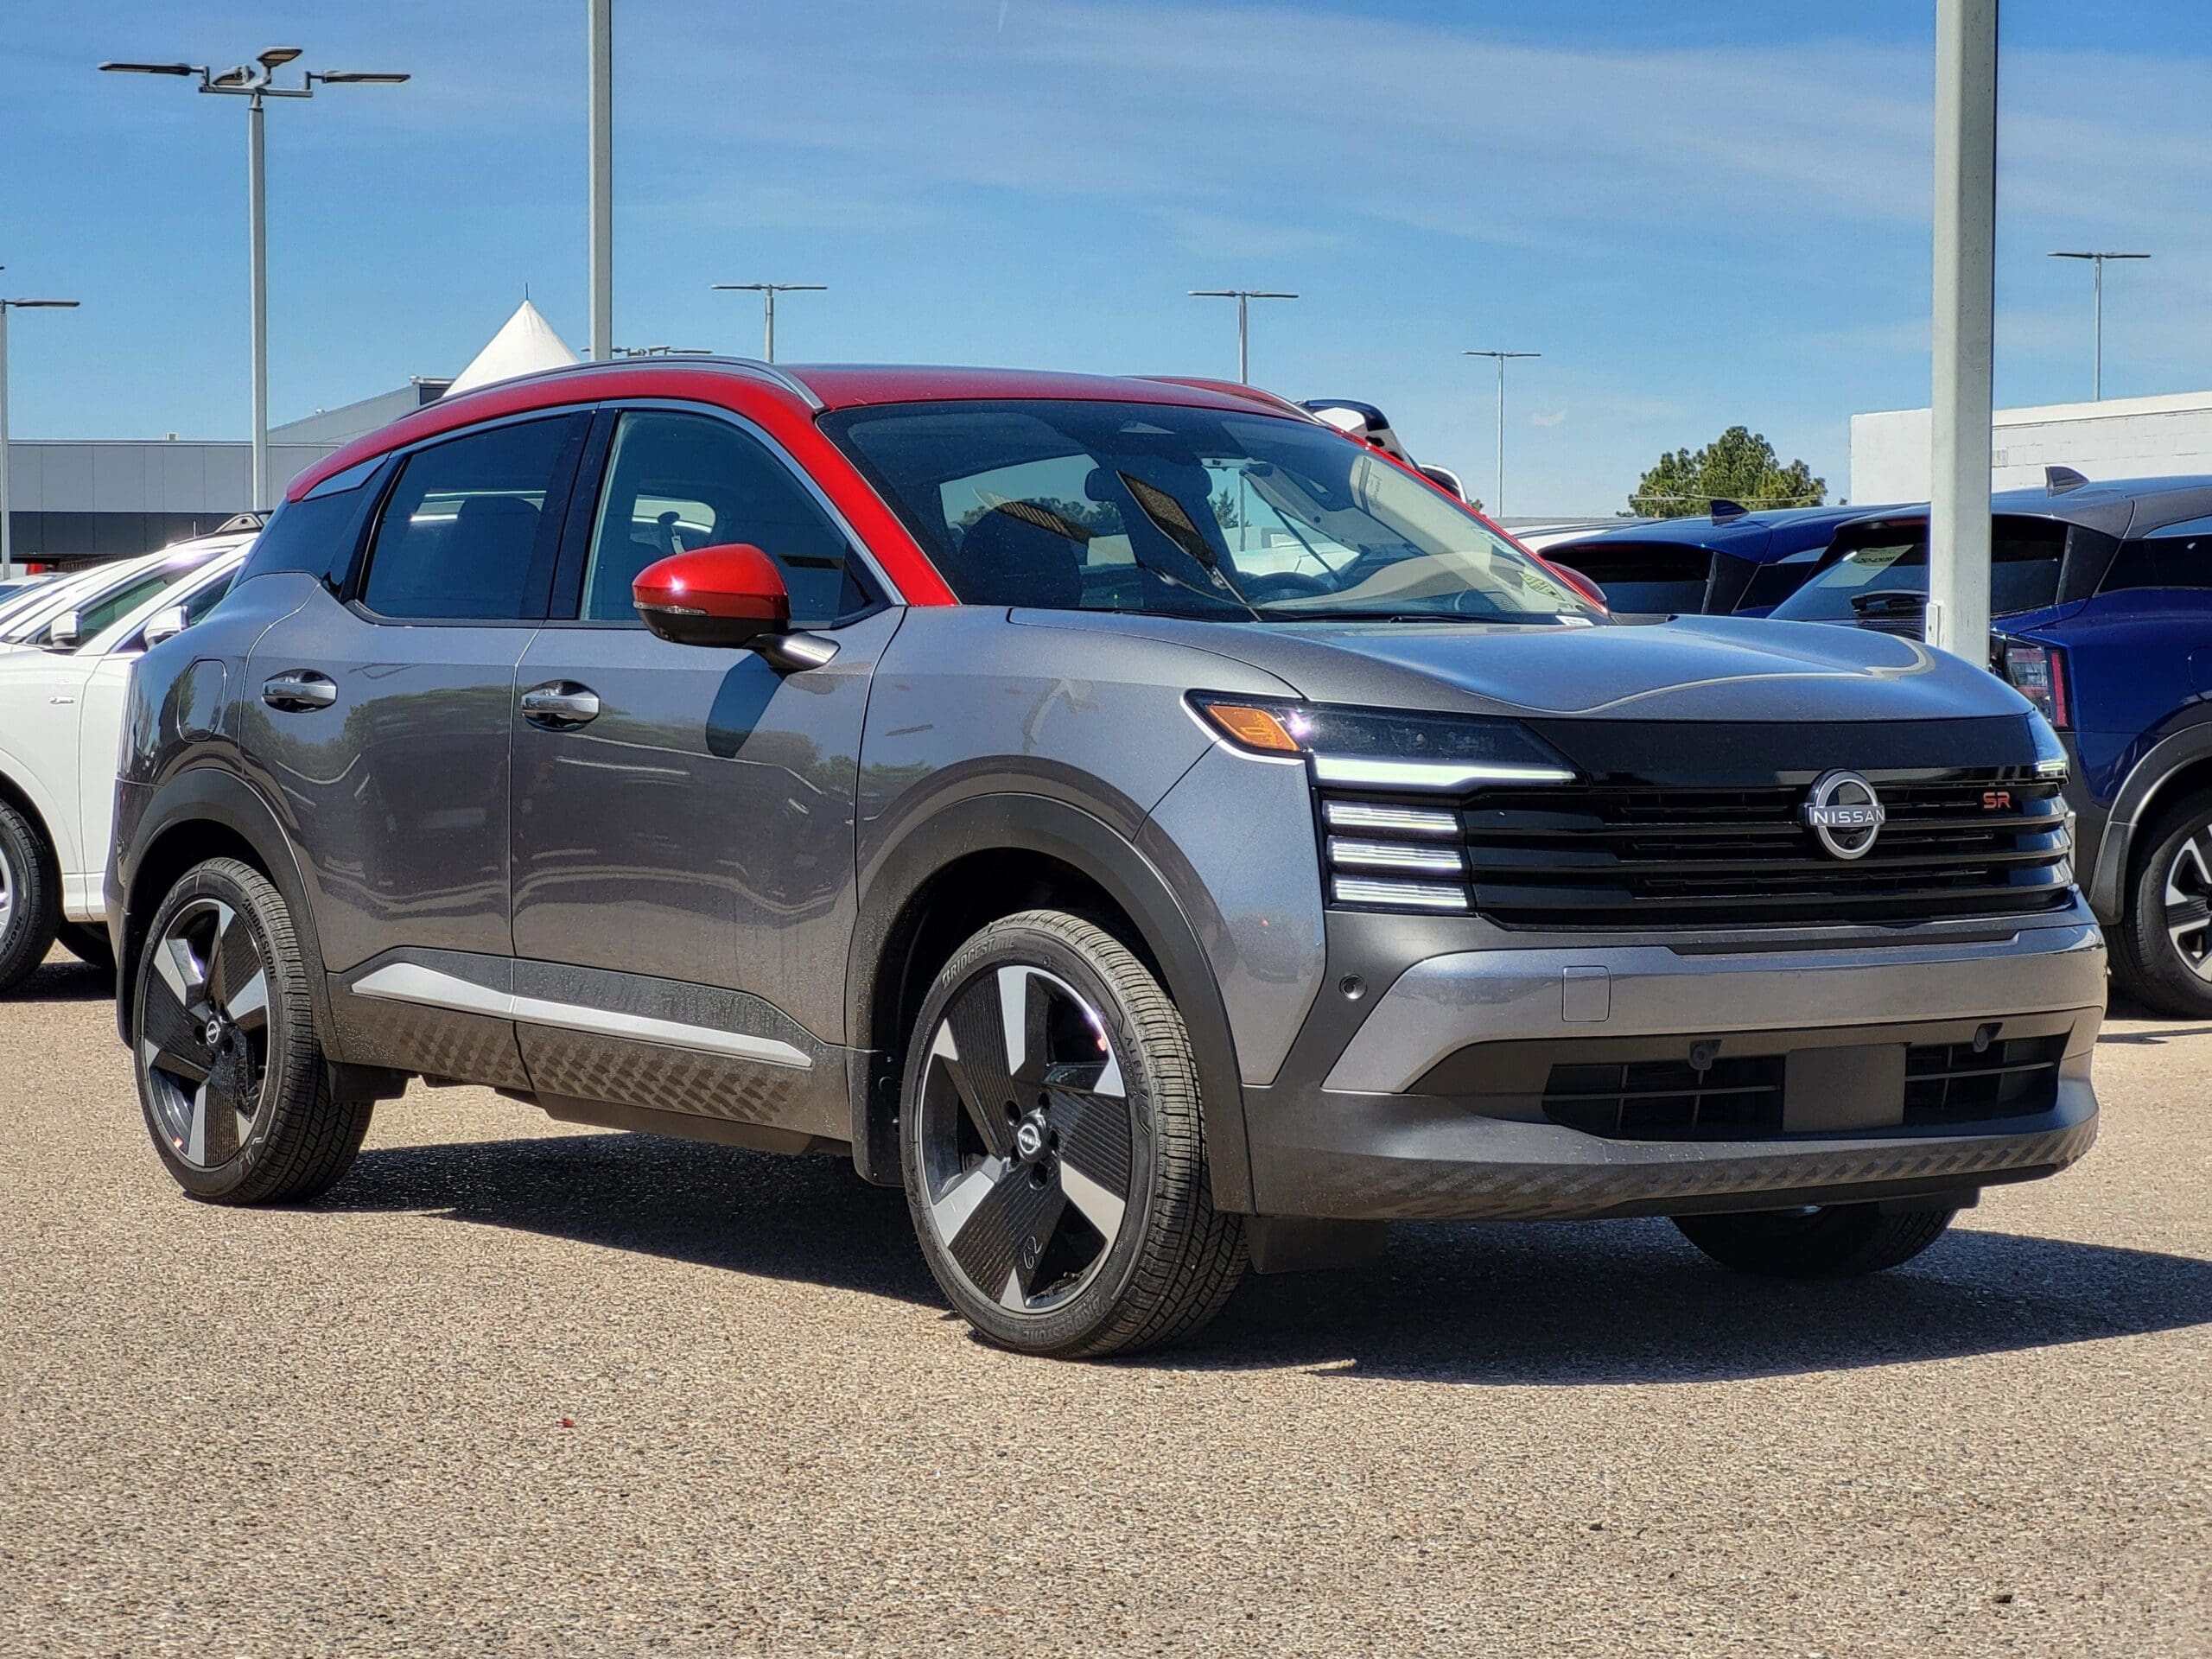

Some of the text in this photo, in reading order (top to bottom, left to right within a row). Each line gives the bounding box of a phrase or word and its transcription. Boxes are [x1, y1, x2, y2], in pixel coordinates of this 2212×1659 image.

[1814, 809, 1885, 824] NISSAN
[1983, 791, 2012, 809] SR
[242, 899, 277, 982] BRIDGESTONE
[942, 936, 1016, 989] BRIDGESTONE
[1024, 1236, 1043, 1269] 62
